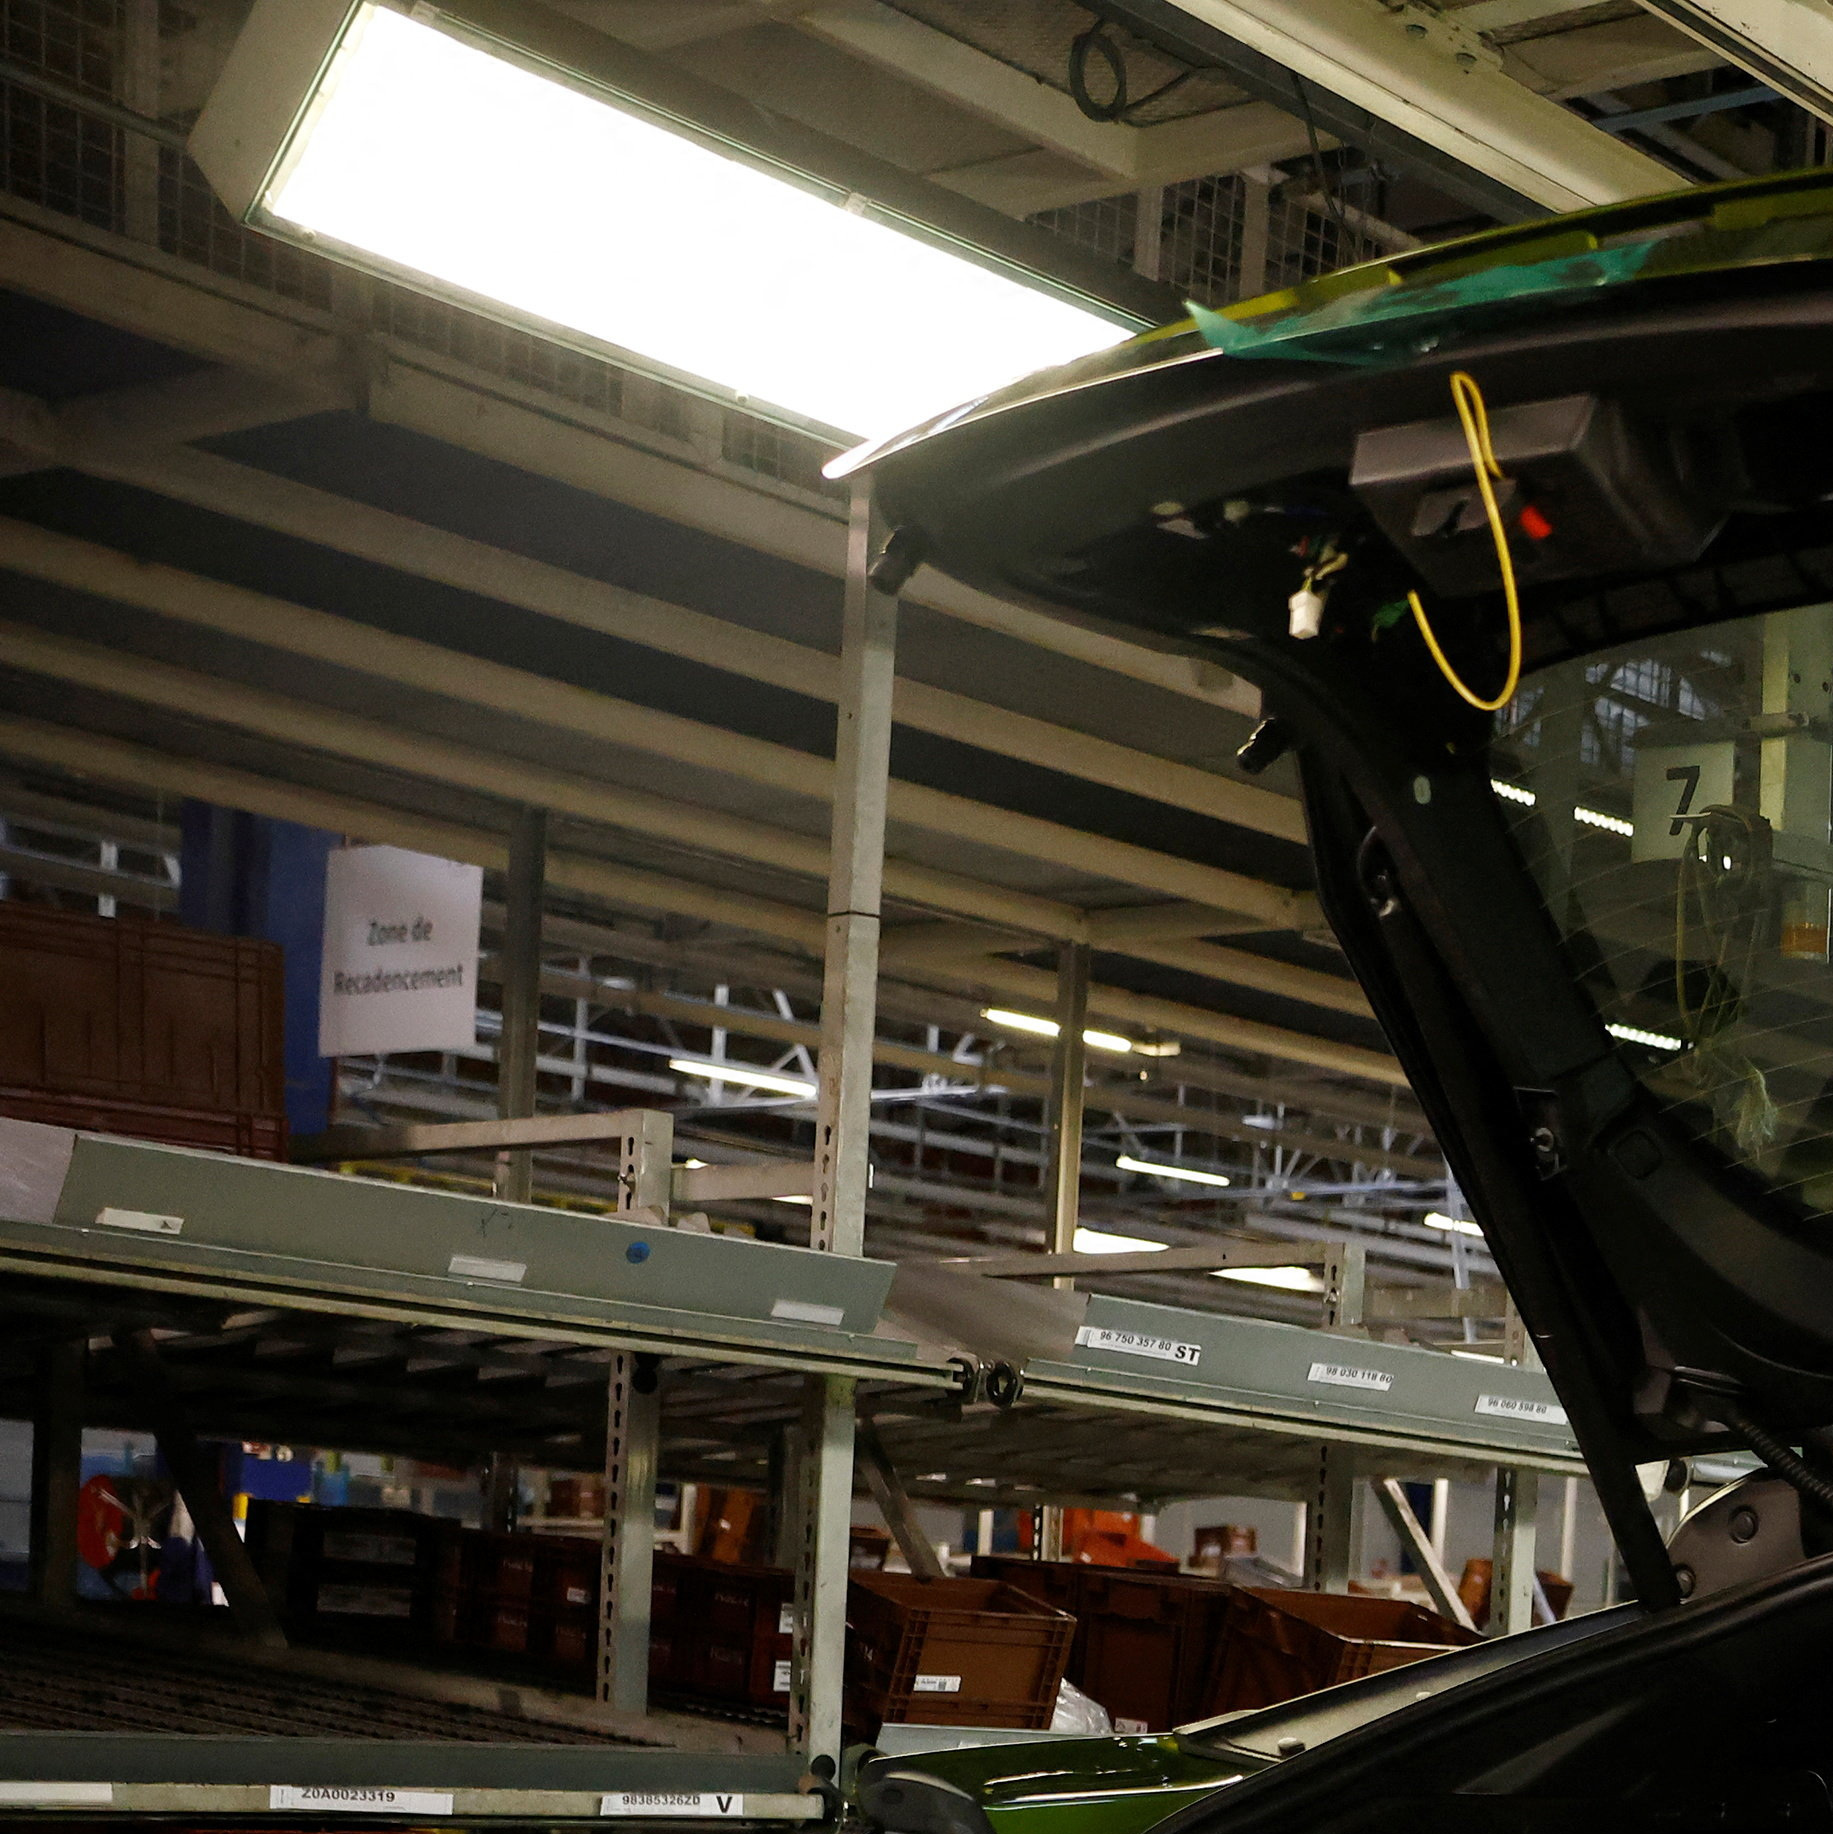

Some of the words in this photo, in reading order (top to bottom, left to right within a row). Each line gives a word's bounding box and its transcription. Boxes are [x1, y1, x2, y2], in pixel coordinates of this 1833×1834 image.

[1666, 765, 1700, 836] 7
[366, 918, 408, 946] Zone
[411, 913, 433, 941] de
[333, 963, 463, 995] Recadencement
[1174, 1345, 1201, 1362] ST
[716, 1796, 733, 1814] V
